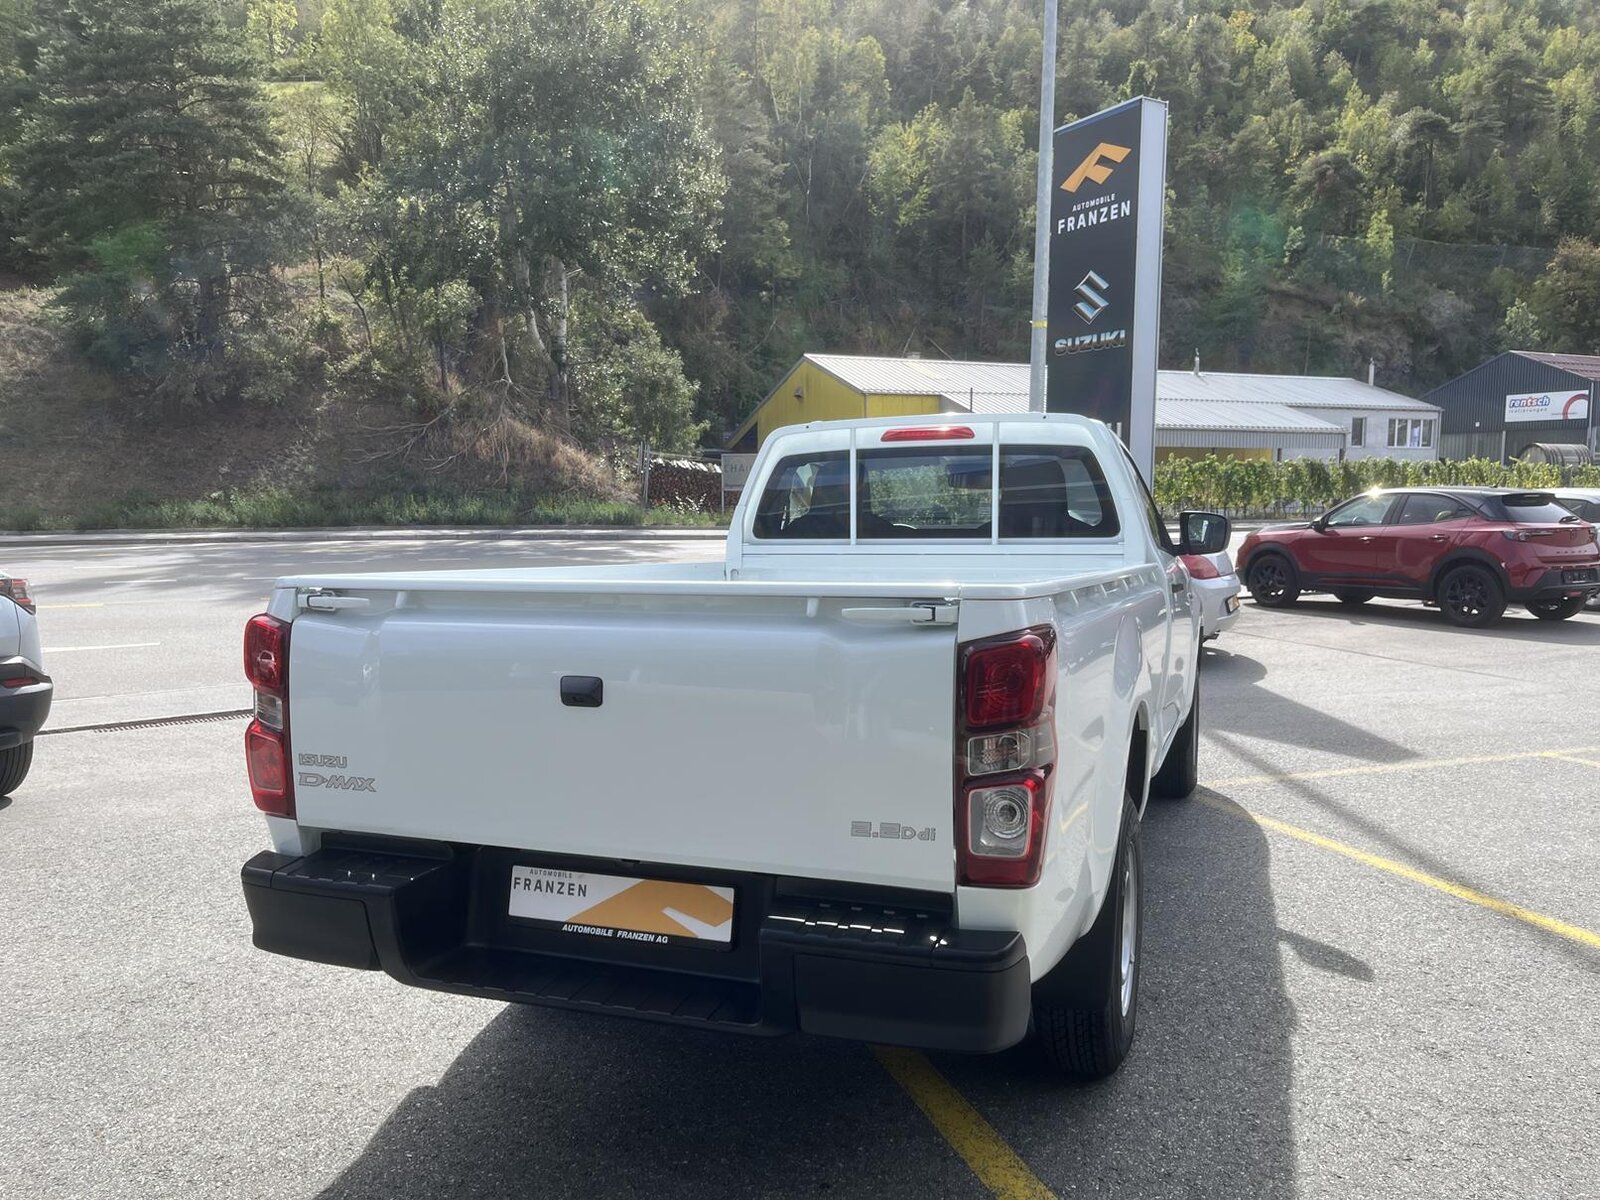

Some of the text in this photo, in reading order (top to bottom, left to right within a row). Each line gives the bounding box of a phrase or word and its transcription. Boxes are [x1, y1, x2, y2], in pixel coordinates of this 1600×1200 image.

[1072, 193, 1116, 212] AUTOMOBILE
[1057, 200, 1131, 234] FRANZEN
[1055, 329, 1126, 356] SUZUKI
[1509, 395, 1551, 408] rentsch
[298, 753, 348, 769] ISUZU
[298, 772, 377, 792] D-MAX
[529, 868, 573, 879] AUTOMOBILE
[513, 877, 587, 897] FRANZEN
[562, 924, 668, 944] AUTOMOBILE FRANZEN AG
